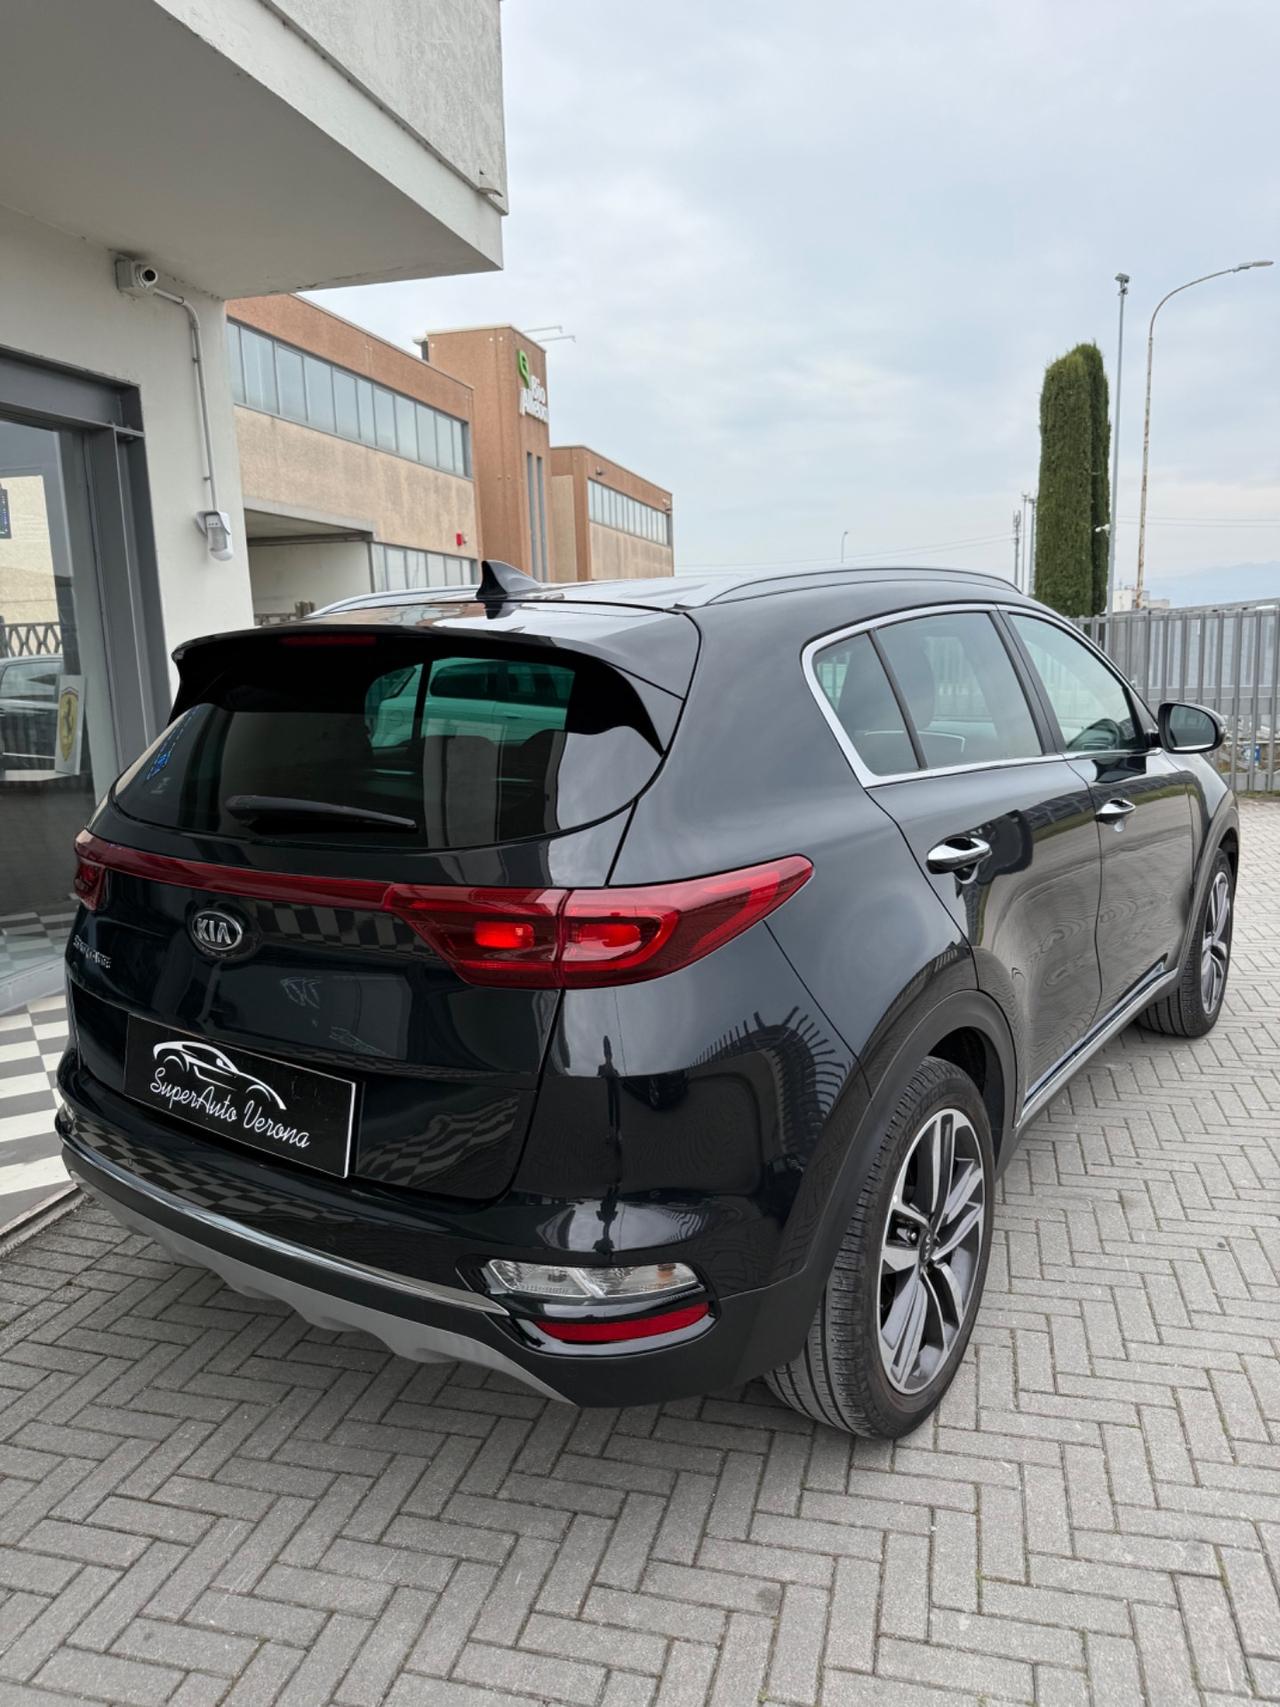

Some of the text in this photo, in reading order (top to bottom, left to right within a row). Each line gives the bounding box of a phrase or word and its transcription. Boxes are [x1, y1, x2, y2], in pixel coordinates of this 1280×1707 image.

[197, 917, 232, 944] KIA
[150, 1066, 311, 1148] SuperAuto Verona
